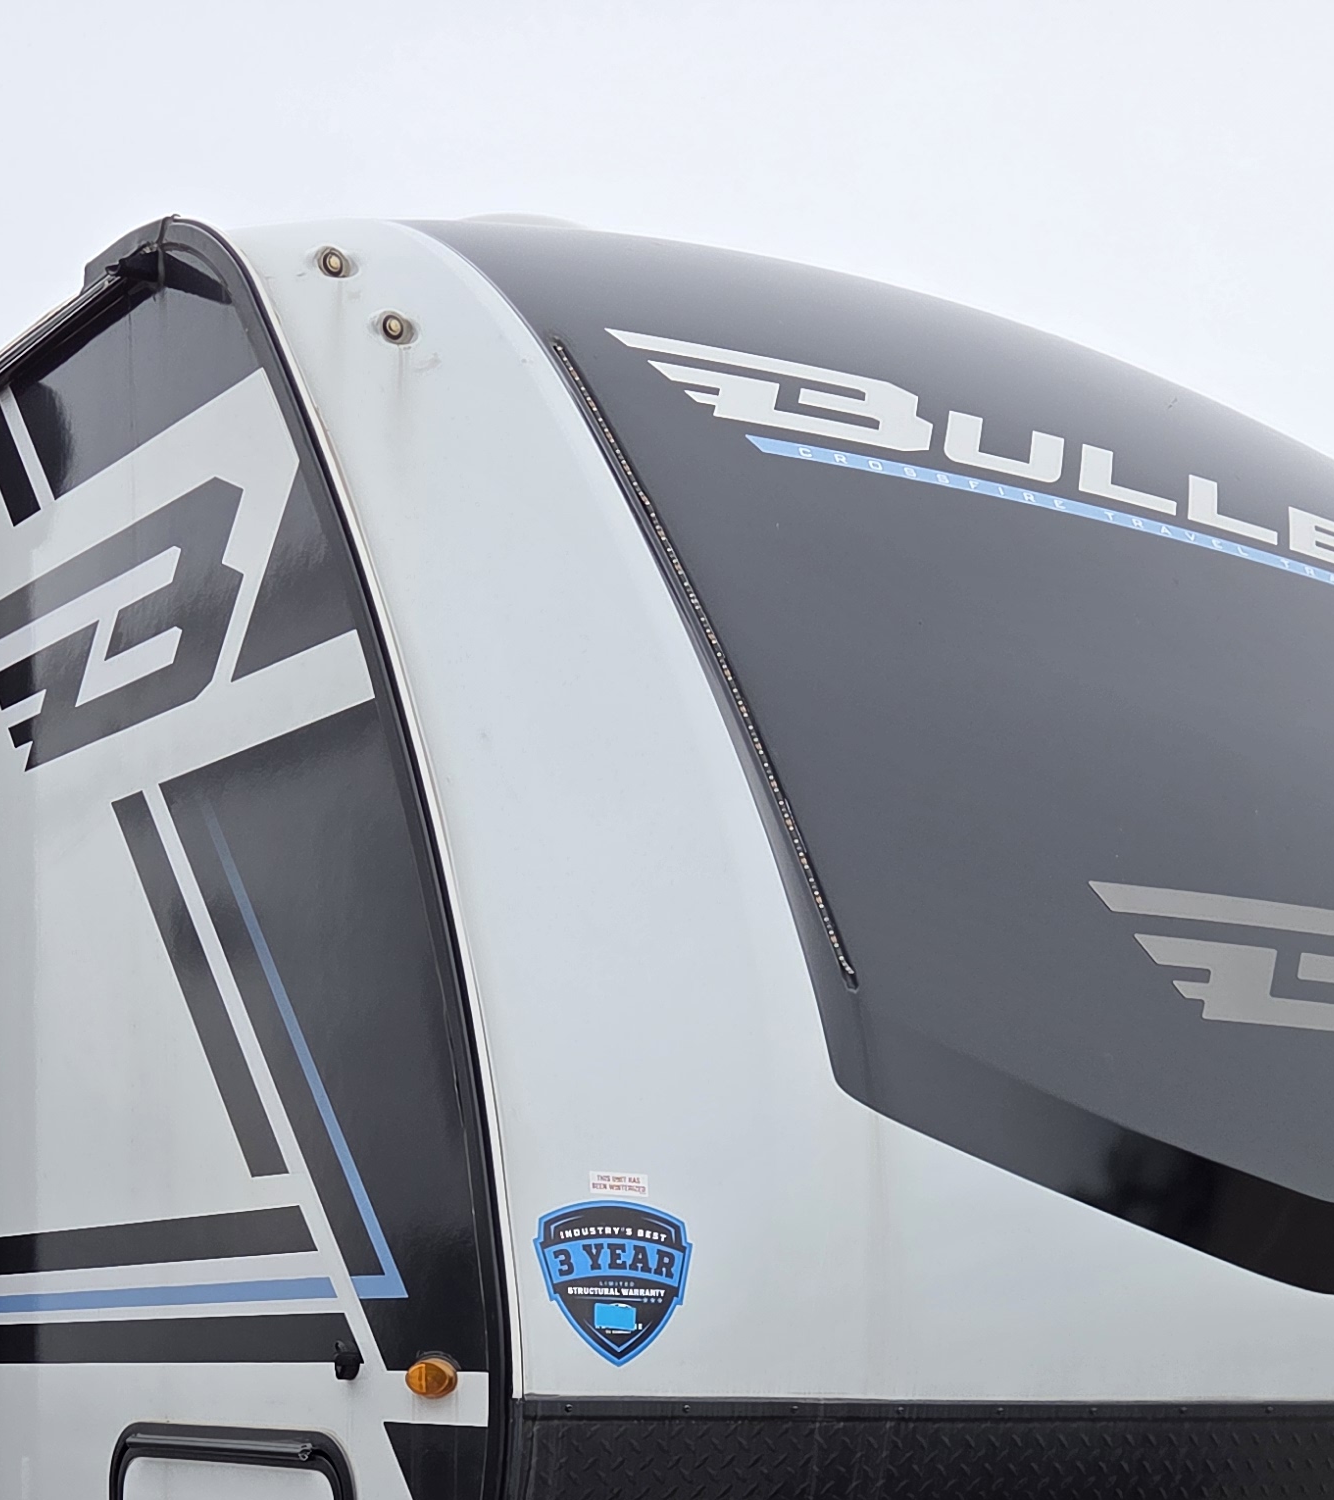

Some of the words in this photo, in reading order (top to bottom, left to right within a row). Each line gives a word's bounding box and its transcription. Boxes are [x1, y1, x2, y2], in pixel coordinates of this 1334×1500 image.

[798, 446, 1067, 510] CROSSFIRE
[1103, 511, 1250, 557] TRAVEL
[596, 1174, 611, 1182] THIS
[612, 1175, 627, 1183] UNIT
[628, 1176, 641, 1184] HAS
[592, 1182, 607, 1190] BEEN
[559, 1226, 633, 1239] INDUSTRY'S
[637, 1228, 668, 1242] BEST
[553, 1248, 575, 1277] 3
[581, 1242, 676, 1280] YEAR
[567, 1286, 620, 1296] STRUCTURAL
[621, 1288, 666, 1297] WARRANTY
